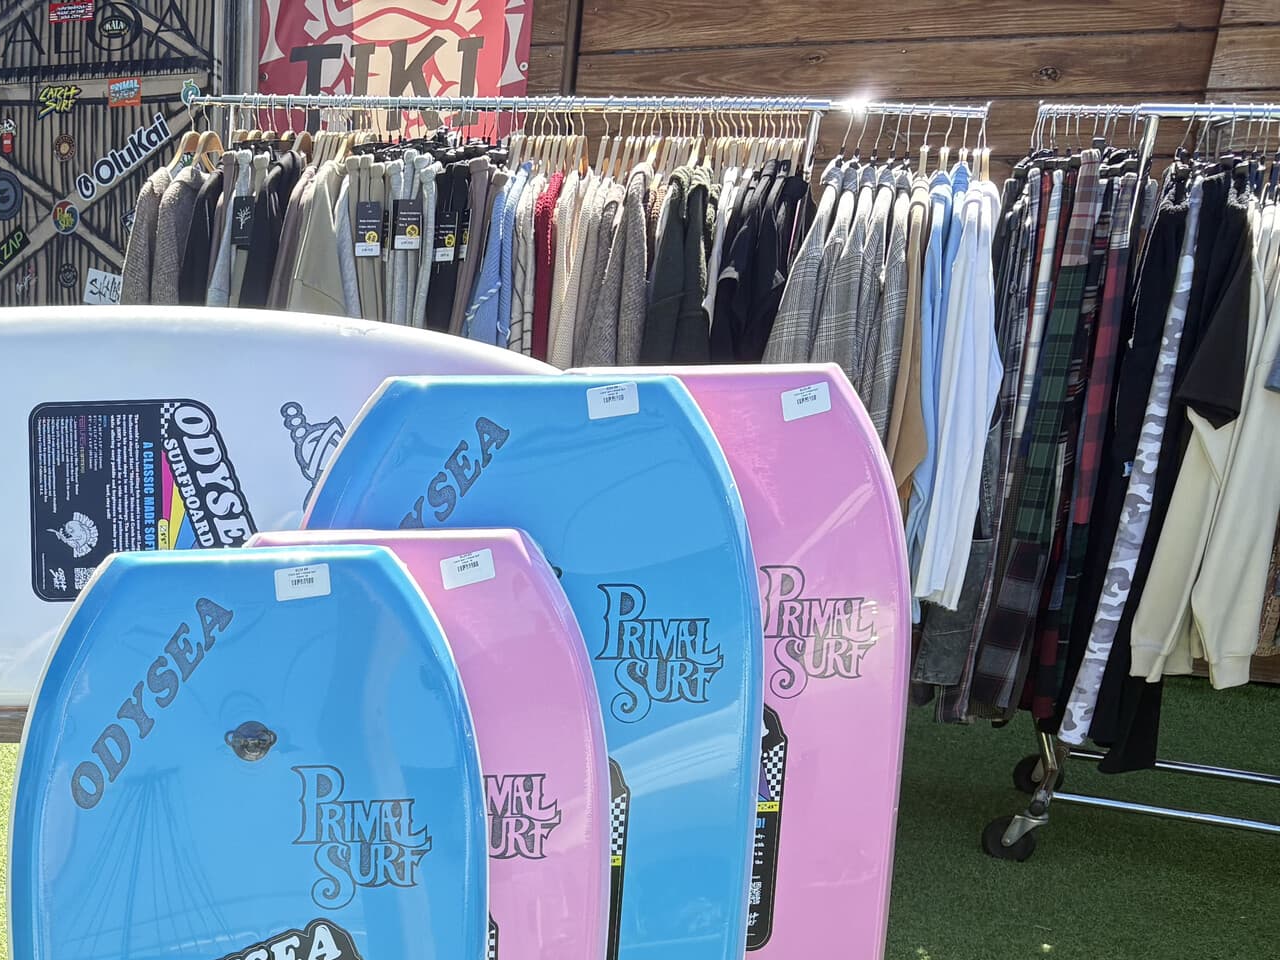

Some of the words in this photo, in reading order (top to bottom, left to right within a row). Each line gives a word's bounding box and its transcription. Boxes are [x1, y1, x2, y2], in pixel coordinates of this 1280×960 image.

[289, 36, 484, 138] TIKI
[93, 115, 171, 185] OluKai
[0, 231, 24, 260] ZAP
[143, 451, 154, 494] CLASSIC
[162, 438, 215, 547] SURFBOARD
[174, 405, 249, 547] ODYSE
[143, 497, 155, 526] MADE
[595, 583, 722, 663] PRIMAL
[761, 565, 875, 641] PRIMAL
[611, 652, 724, 722] SURF
[769, 634, 877, 699] SURF
[71, 597, 234, 810] ODYSEA
[290, 765, 431, 848] PRIMAL
[483, 774, 561, 821] MAL
[488, 812, 562, 860] URF
[311, 838, 432, 910] SURF
